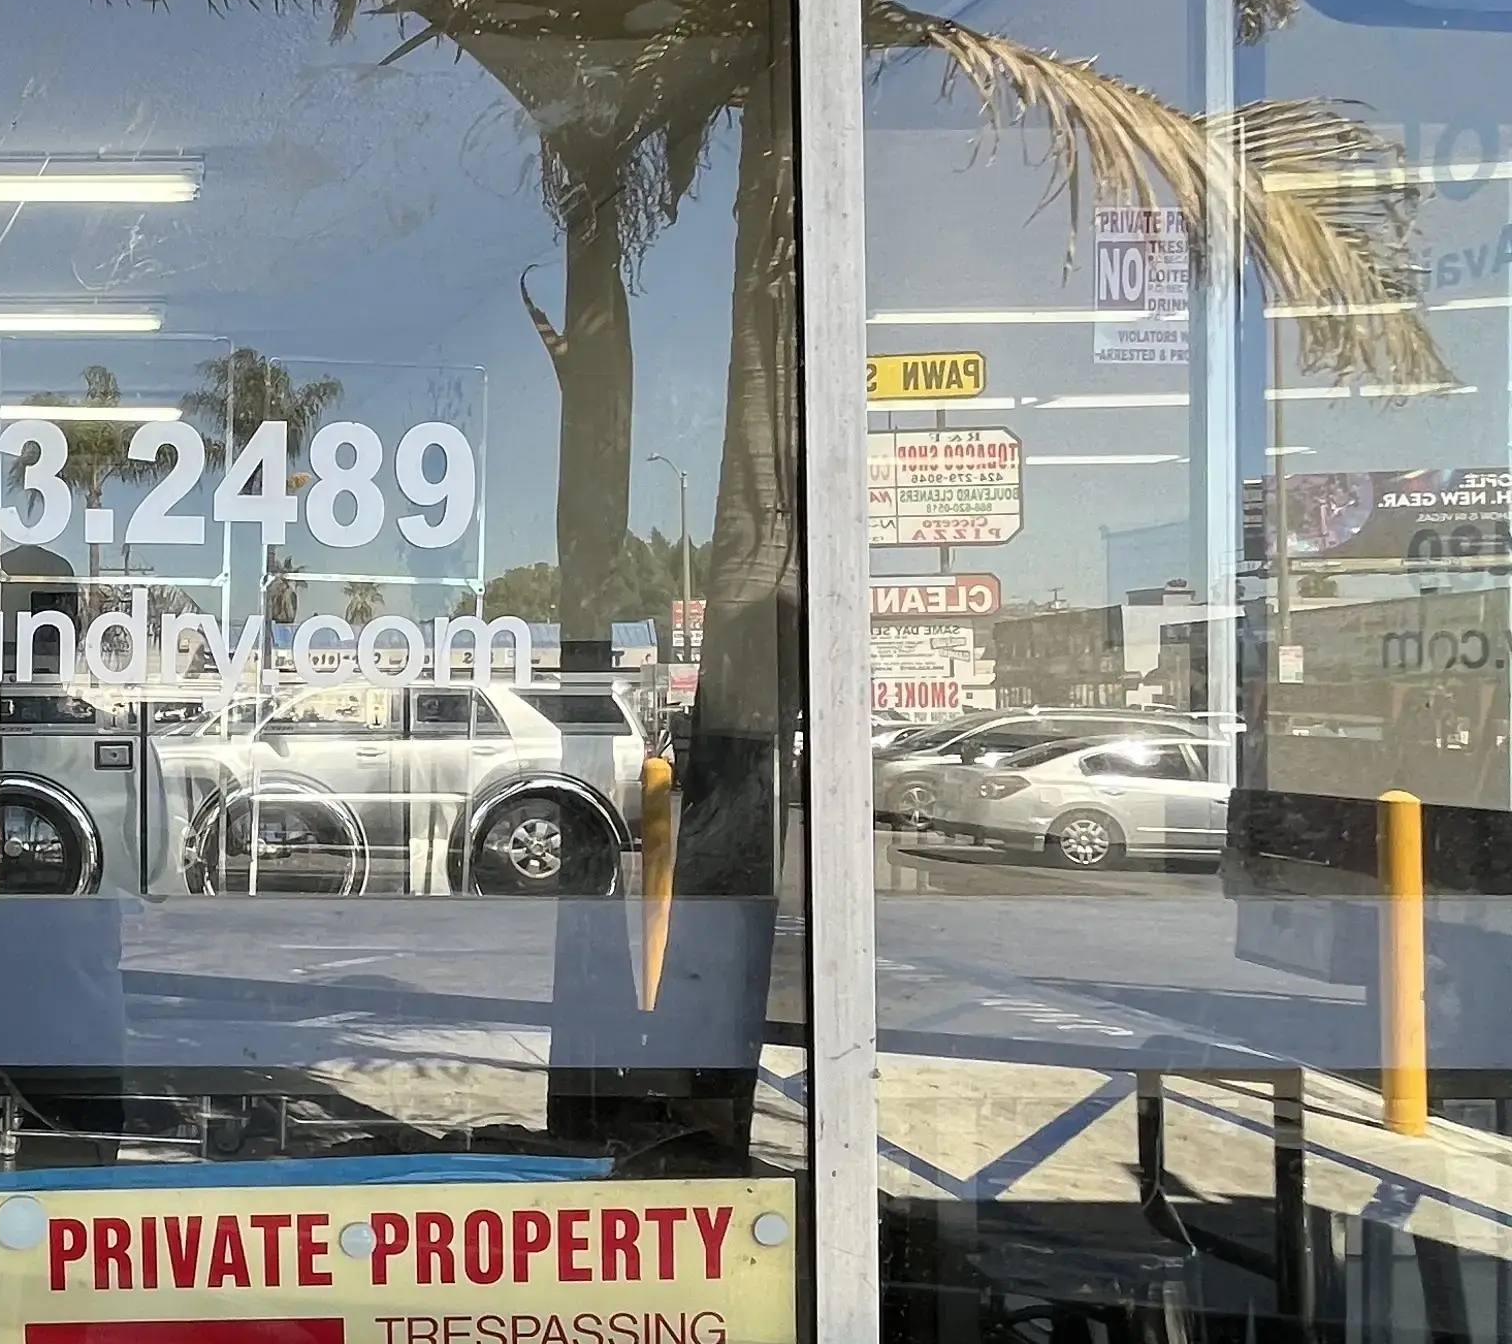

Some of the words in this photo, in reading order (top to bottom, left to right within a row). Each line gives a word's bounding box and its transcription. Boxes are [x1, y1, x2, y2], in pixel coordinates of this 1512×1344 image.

[1099, 210, 1162, 234] PRIVATE
[1099, 247, 1143, 301] NO
[48, 1211, 334, 1293] PRIVATE
[370, 1204, 734, 1287] PROPERTY
